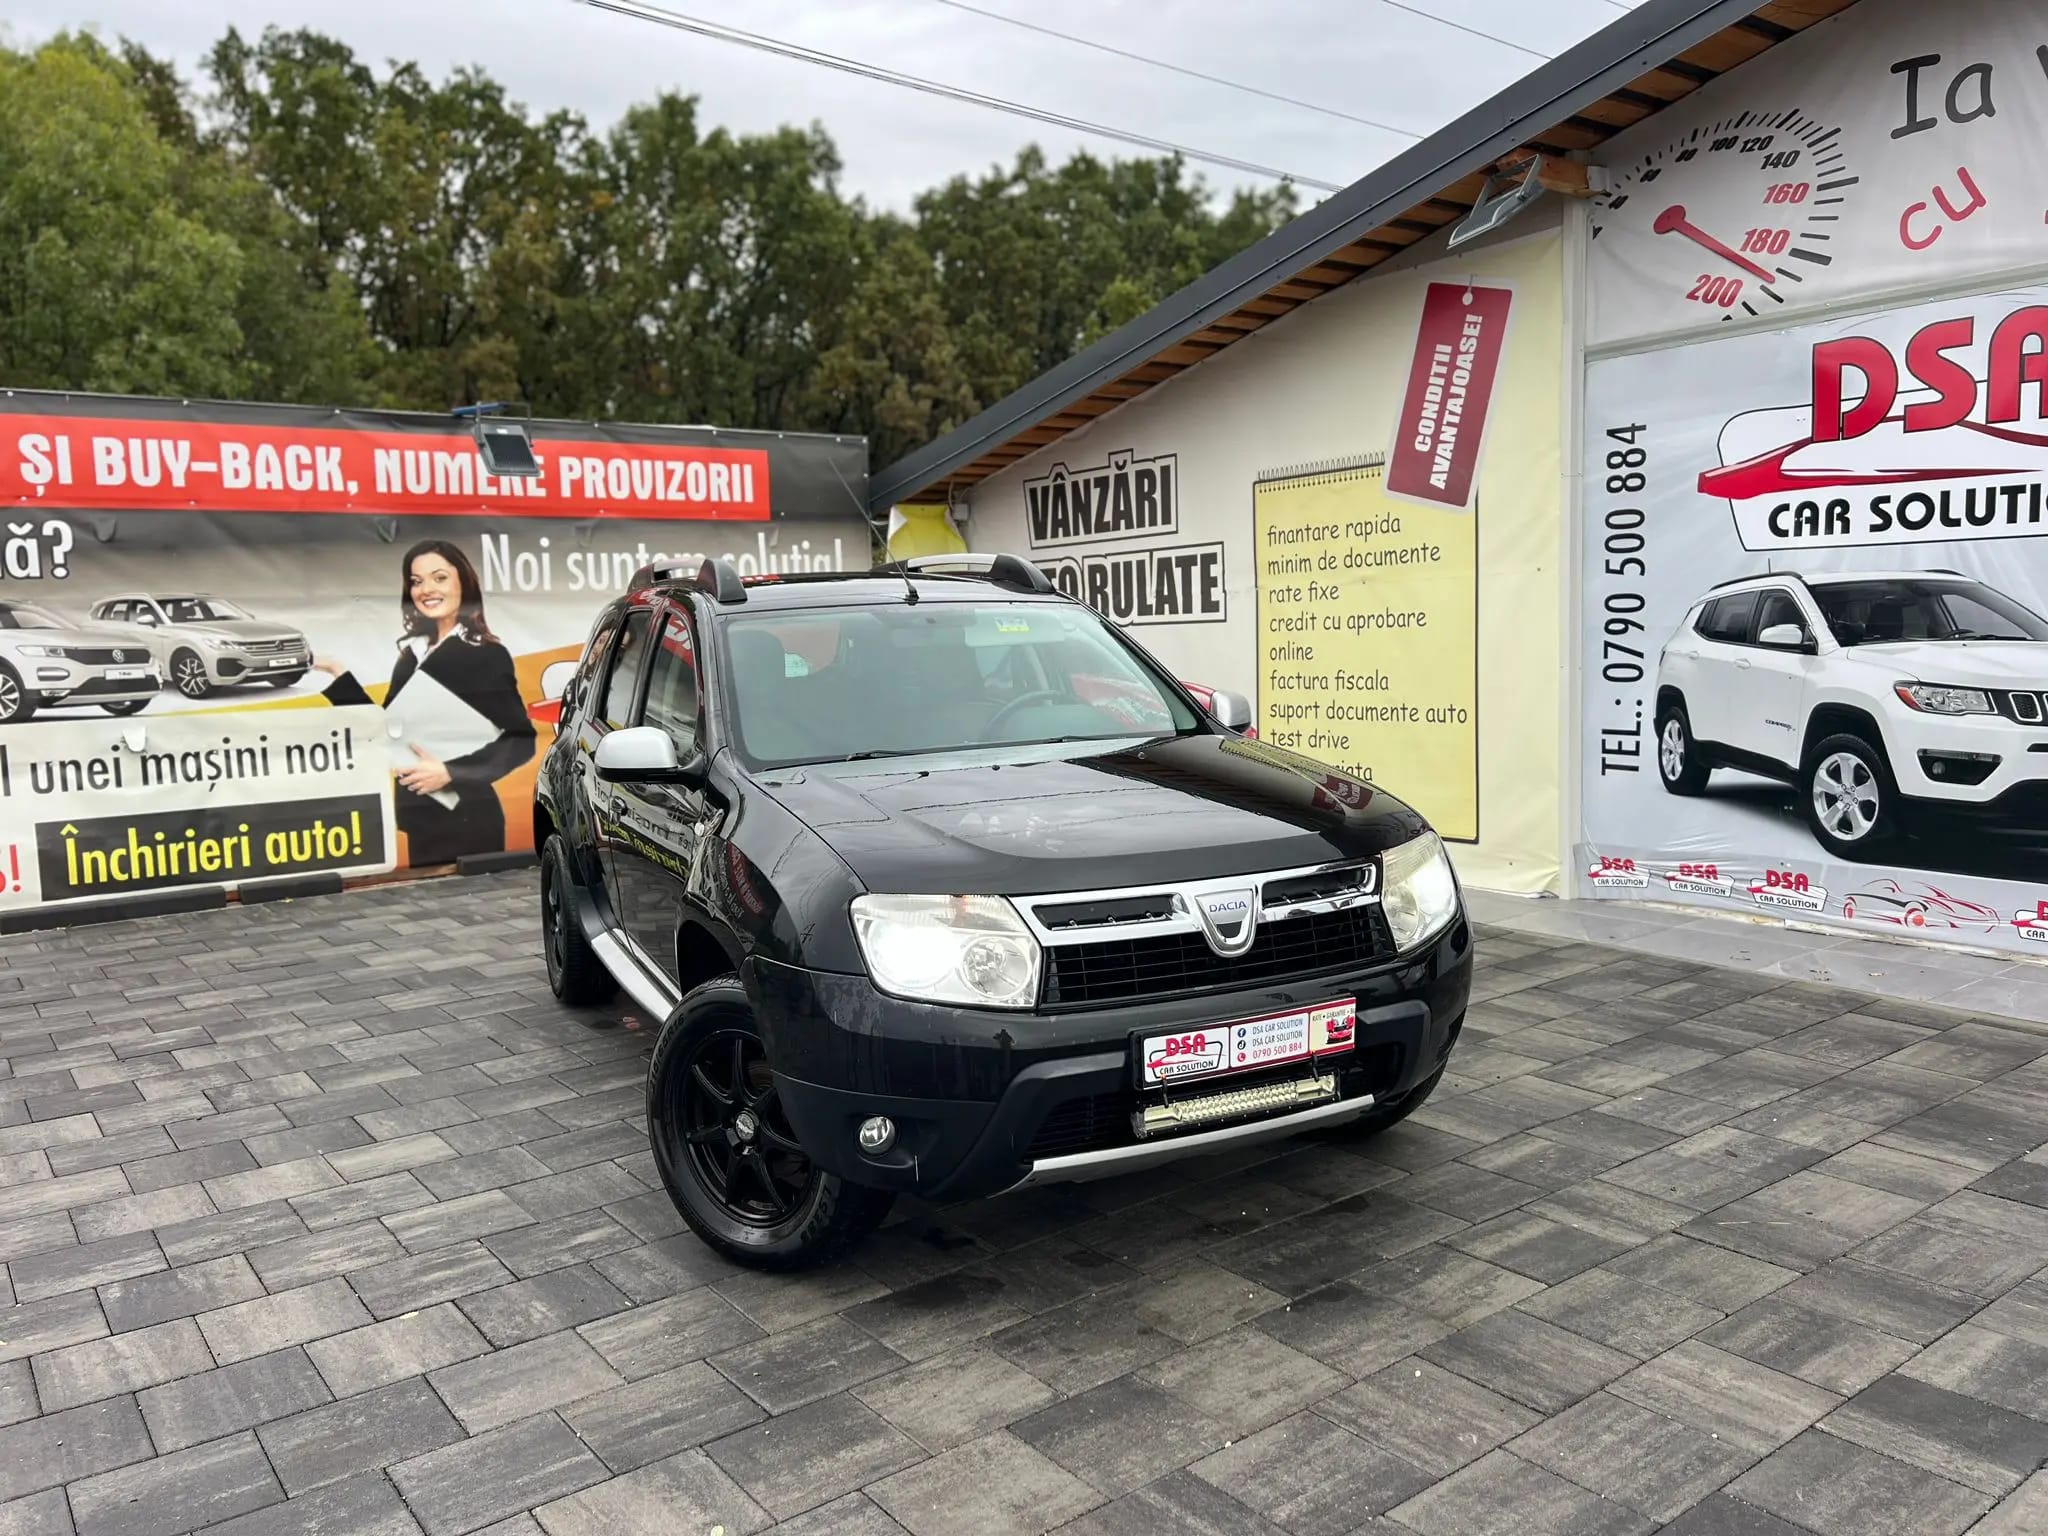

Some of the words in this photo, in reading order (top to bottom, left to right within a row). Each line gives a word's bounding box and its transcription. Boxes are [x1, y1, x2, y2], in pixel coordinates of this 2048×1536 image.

[1890, 53, 1996, 140] Ia
[1708, 135, 1740, 153] 100
[1739, 135, 1775, 153] 120
[1760, 150, 1801, 170] 140
[1762, 182, 1811, 204] 160
[1899, 166, 1987, 250] cu
[1740, 229, 1791, 255] 180
[1685, 274, 1744, 308] 200
[1811, 304, 2048, 443] DSA
[1414, 343, 1453, 452] CONDITII
[1428, 313, 1484, 491] AVANTAJOASE!
[18, 433, 73, 497] ȘI
[558, 455, 754, 503] PROVIZORII
[1605, 422, 1647, 494] 884
[1028, 458, 1172, 541] VÂNZĂRI
[1768, 497, 1851, 538] CAR
[1869, 482, 2048, 533] SOLUTI
[1267, 523, 1340, 547] finantare
[1345, 512, 1401, 543] rapida
[0, 520, 75, 580] ă?
[1604, 508, 1646, 577] 500
[480, 533, 552, 593] Noi
[1267, 553, 1312, 576] minim
[1317, 550, 1338, 571] de
[1343, 542, 1441, 569] documente
[1269, 584, 1303, 604] rate
[1308, 580, 1340, 602] fixe
[1269, 611, 1317, 632] credit
[1322, 615, 1341, 631] cu
[1346, 607, 1427, 636] aprobare
[1601, 592, 1646, 683] 0790
[1269, 640, 1314, 661] online
[1270, 669, 1329, 691] factura
[1334, 668, 1390, 691] fiscala
[1269, 701, 1320, 724] suport
[1326, 700, 1420, 723] documente
[1425, 703, 1468, 724] auto
[1270, 730, 1303, 748] test
[1308, 728, 1351, 750] drive
[1600, 698, 1643, 777] TEL.:
[30, 744, 123, 795] unei
[140, 734, 271, 793] mașini
[285, 727, 355, 775] noi!
[60, 823, 251, 886] Închirieri
[265, 810, 363, 866] auto!
[1600, 856, 1637, 871] DSA
[1679, 863, 1718, 880] DSA
[1597, 878, 1610, 886] CAR
[1611, 878, 1644, 887] SOLUTION
[1674, 882, 1688, 891] CAR
[1689, 883, 1726, 896] SOLUTION
[1765, 869, 1809, 892] DSA
[1208, 900, 1247, 913] DACIA
[1759, 894, 1776, 904] CAR
[1776, 895, 1818, 910] SOLUTION
[2026, 929, 2046, 939] CAR
[1252, 1025, 1264, 1035] DSA
[1265, 1023, 1276, 1032] CAR
[1276, 1018, 1303, 1030] SOLUTION
[1252, 1037, 1264, 1047] DSA
[1264, 1035, 1275, 1044] CAR
[1276, 1030, 1303, 1042] SOLUTION
[1165, 1033, 1206, 1057] DSA
[1252, 1047, 1272, 1059] 0790
[1274, 1045, 1287, 1056] 500
[1288, 1042, 1303, 1052] 884
[1159, 1065, 1176, 1075] CAR
[1177, 1059, 1214, 1073] SOLUTION
